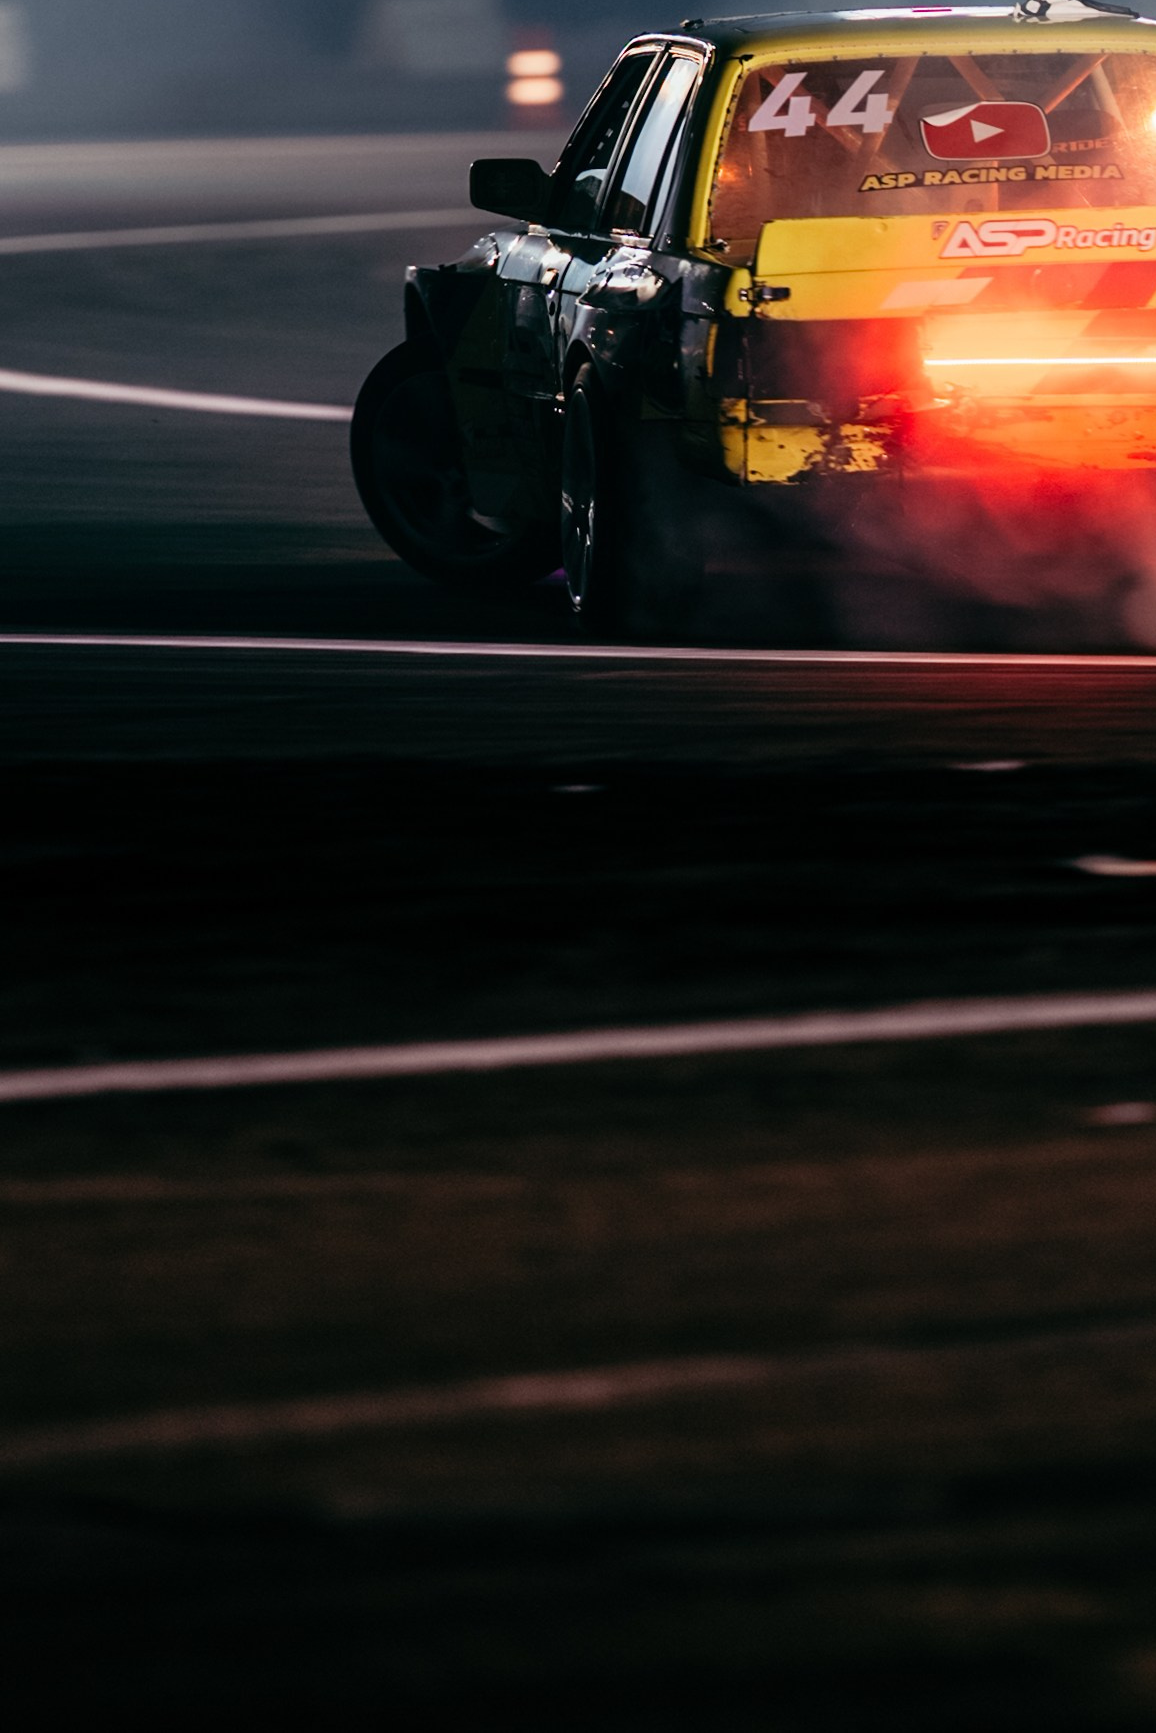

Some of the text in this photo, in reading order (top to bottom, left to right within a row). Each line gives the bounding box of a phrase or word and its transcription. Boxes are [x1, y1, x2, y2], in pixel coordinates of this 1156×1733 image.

[748, 70, 894, 137] 44
[861, 165, 1122, 190] ASP RACING MEDIA
[939, 219, 1057, 258] ASP
